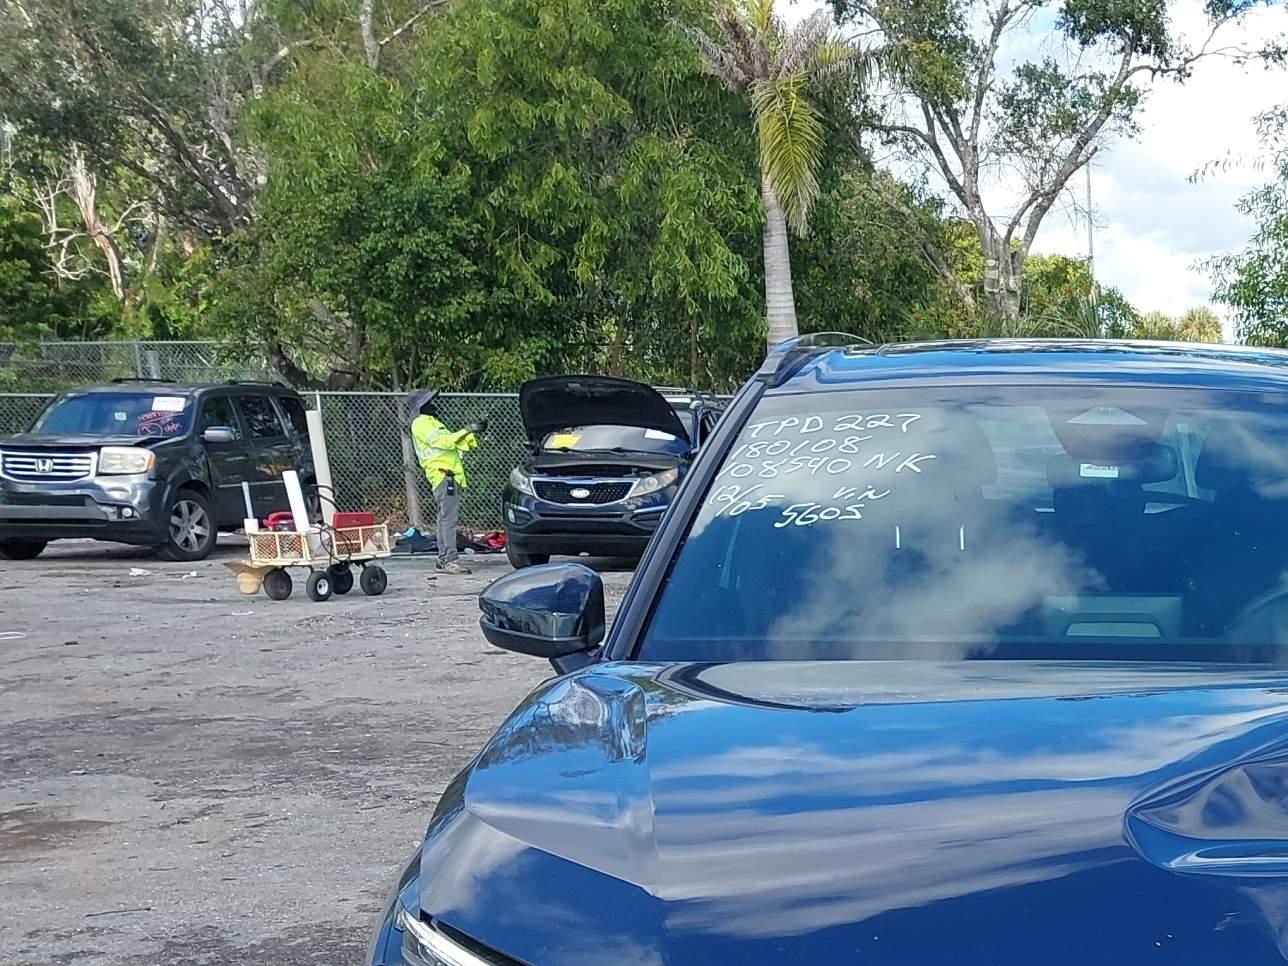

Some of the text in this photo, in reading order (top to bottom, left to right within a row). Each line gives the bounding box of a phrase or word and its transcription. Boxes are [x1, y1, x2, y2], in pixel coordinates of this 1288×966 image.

[748, 413, 922, 438] TPD 227
[730, 435, 873, 460] 180108
[863, 452, 937, 473] NK
